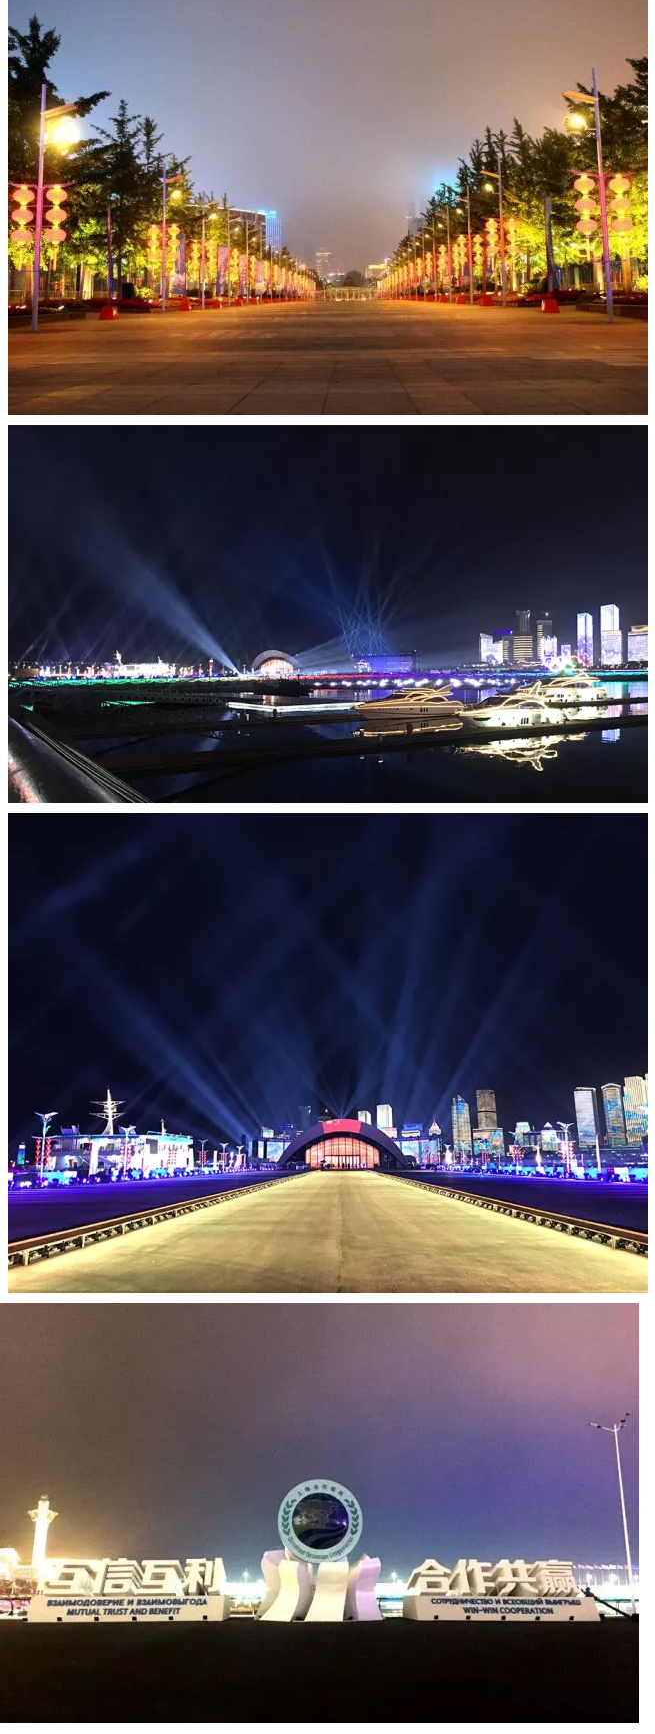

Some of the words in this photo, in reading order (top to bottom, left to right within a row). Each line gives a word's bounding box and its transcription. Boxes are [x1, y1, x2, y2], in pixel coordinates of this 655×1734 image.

[44, 1557, 224, 1596] 互信互利
[407, 1558, 579, 1597] 合作共赢
[47, 1599, 125, 1607] ВЗАИМОДОВЕРИЕ
[127, 1598, 134, 1606] И
[136, 1598, 208, 1606] ВЗАИМОВЫГОДА
[66, 1608, 100, 1616] MUTUAL
[103, 1608, 128, 1616] TRUST
[149, 1607, 181, 1615] BENEFIT
